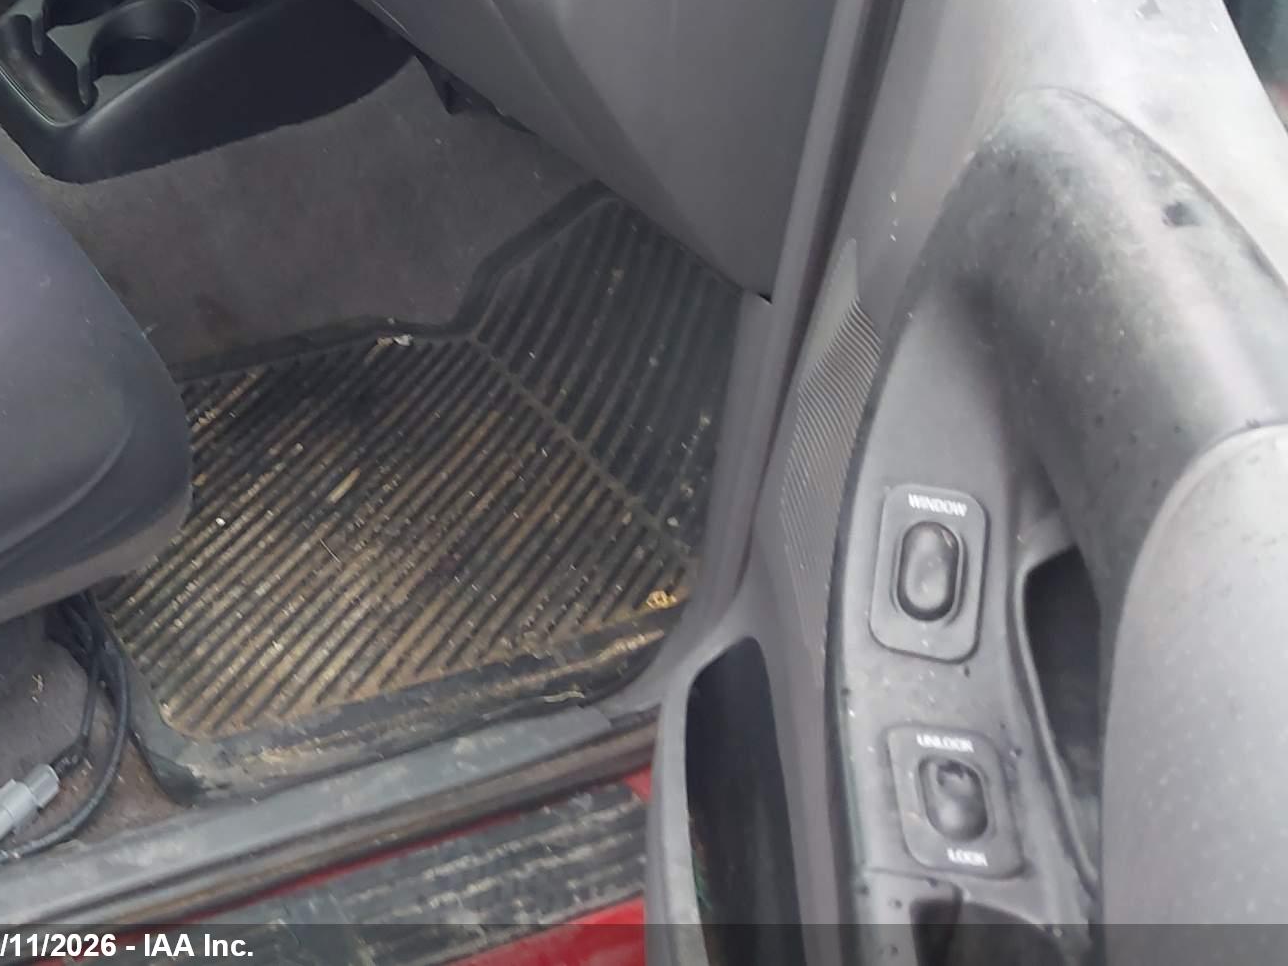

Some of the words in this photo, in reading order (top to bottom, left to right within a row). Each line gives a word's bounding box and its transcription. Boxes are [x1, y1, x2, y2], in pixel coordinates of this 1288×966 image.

[907, 492, 968, 517] WINDOW
[915, 733, 974, 753] UNLOCK
[946, 847, 988, 867] LOCK
